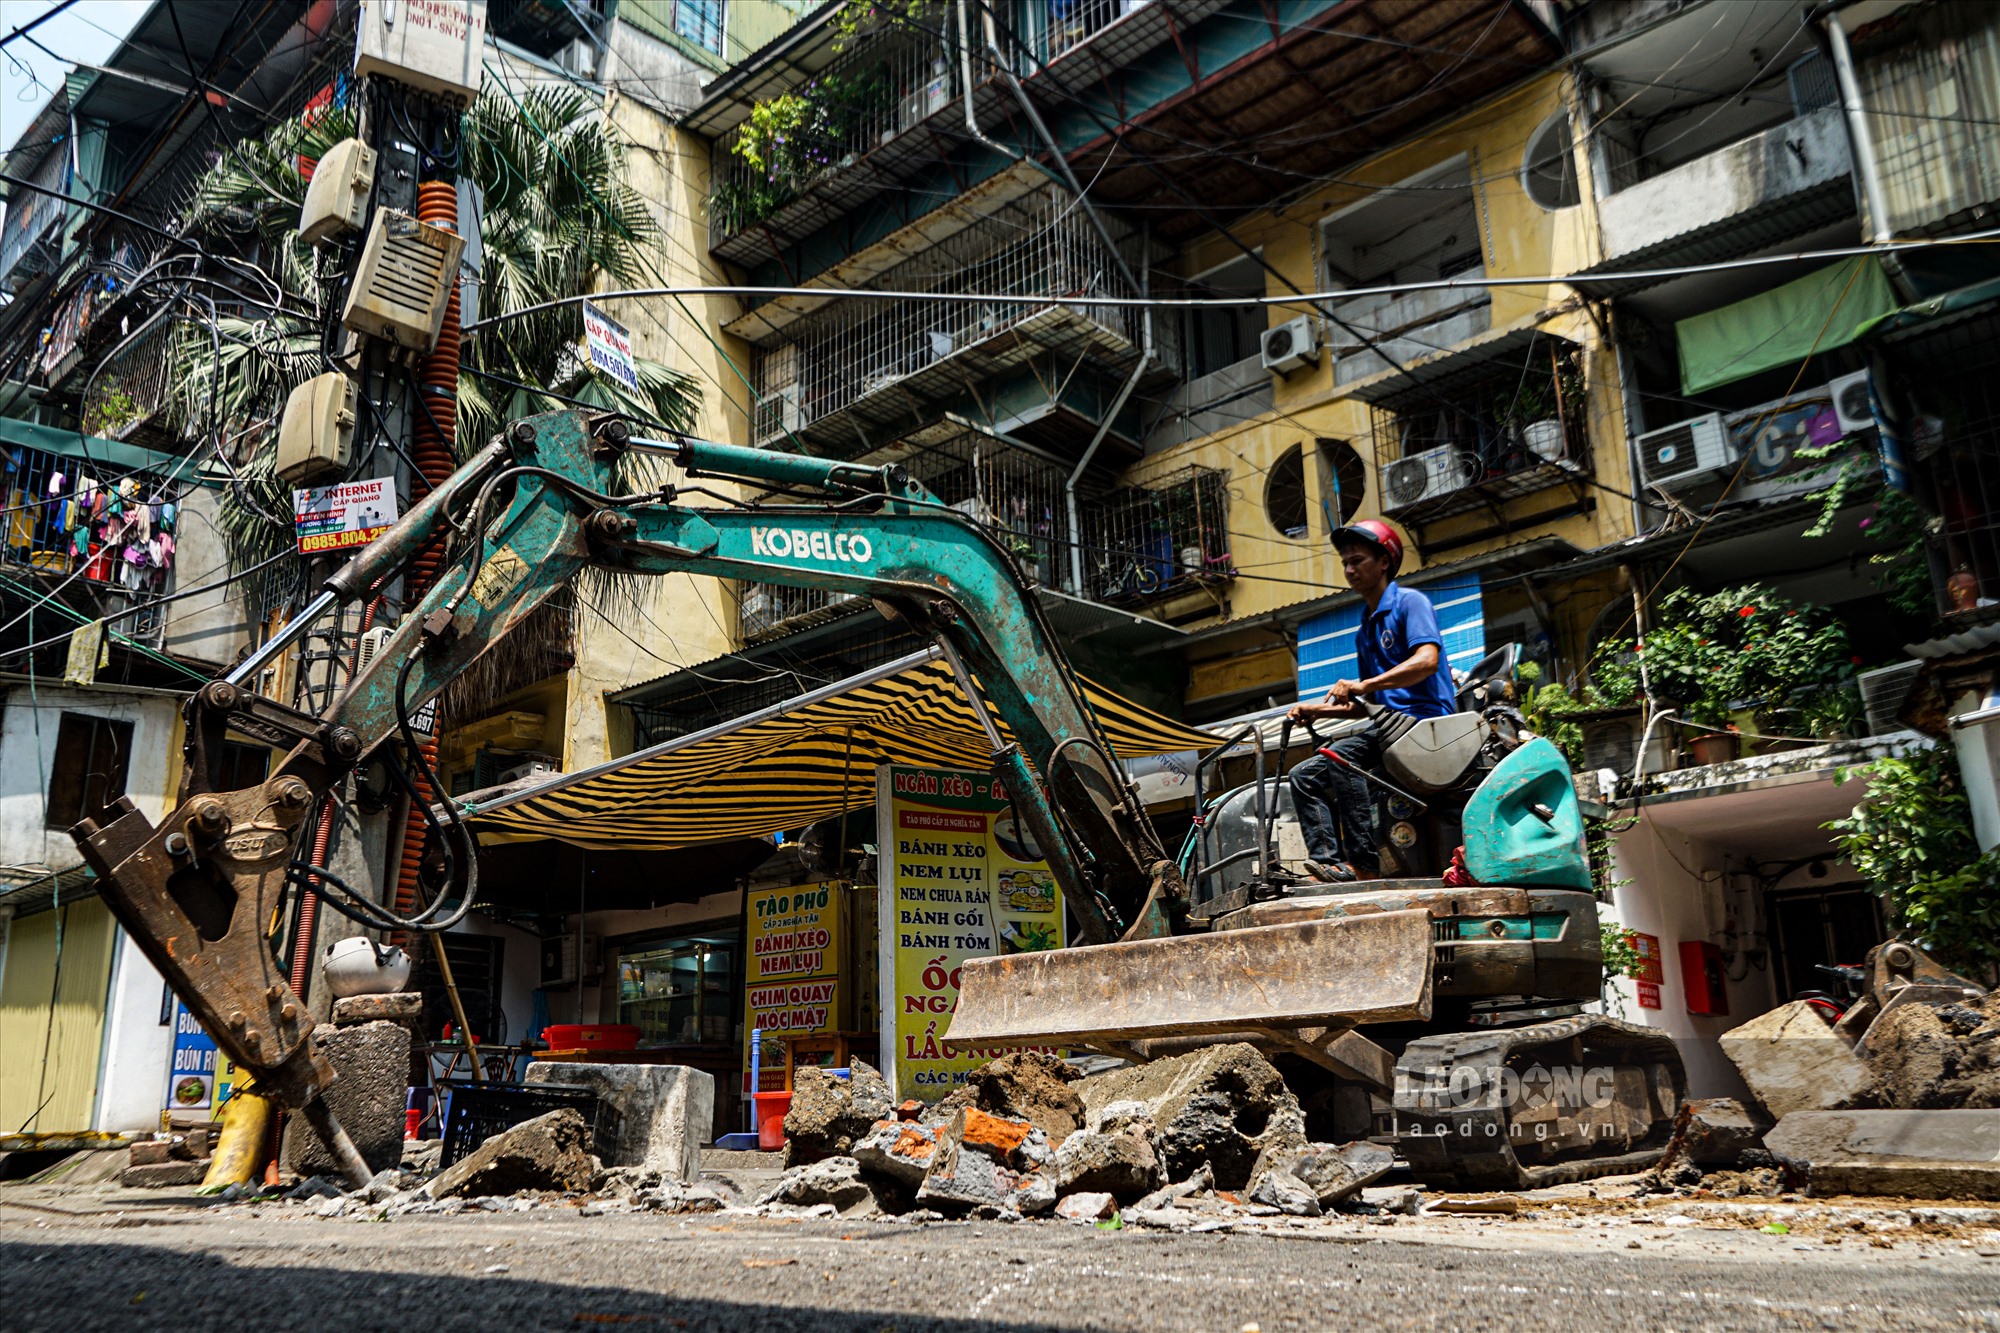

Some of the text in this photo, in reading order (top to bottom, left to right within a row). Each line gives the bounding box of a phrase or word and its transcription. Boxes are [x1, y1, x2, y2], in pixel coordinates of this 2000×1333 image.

[604, 330, 631, 358] QUANG
[324, 482, 383, 500] INTERNET
[351, 494, 380, 504] QUANG
[302, 525, 393, 551] 0985.804.25
[750, 526, 872, 563] KOBELCO
[895, 771, 938, 795] NGÂN
[942, 775, 973, 797] XÈO
[906, 814, 918, 824] TÀO
[932, 815, 943, 827] CẤP
[950, 817, 968, 828] NGHĨA
[969, 818, 981, 828] TÂN
[900, 838, 986, 858] BÁNH XÈO
[900, 864, 982, 884] NEM LỤI
[900, 887, 990, 904] NEM CHUA RÁN
[756, 895, 789, 917] TÀO
[763, 913, 819, 929] CẤP 2 NGHĨA TÂN
[900, 908, 984, 927] BÁNH GỐI
[754, 928, 829, 954] BÁNH XÈO
[901, 931, 990, 950] BÁNH TÔM
[760, 952, 821, 975] NEM LỤI
[750, 984, 834, 1008] CHIM QUAY
[904, 995, 957, 1014] NG
[755, 1005, 826, 1031] MÓC MẬT
[174, 1045, 201, 1071] BÚN
[915, 1069, 948, 1084] CÁC
